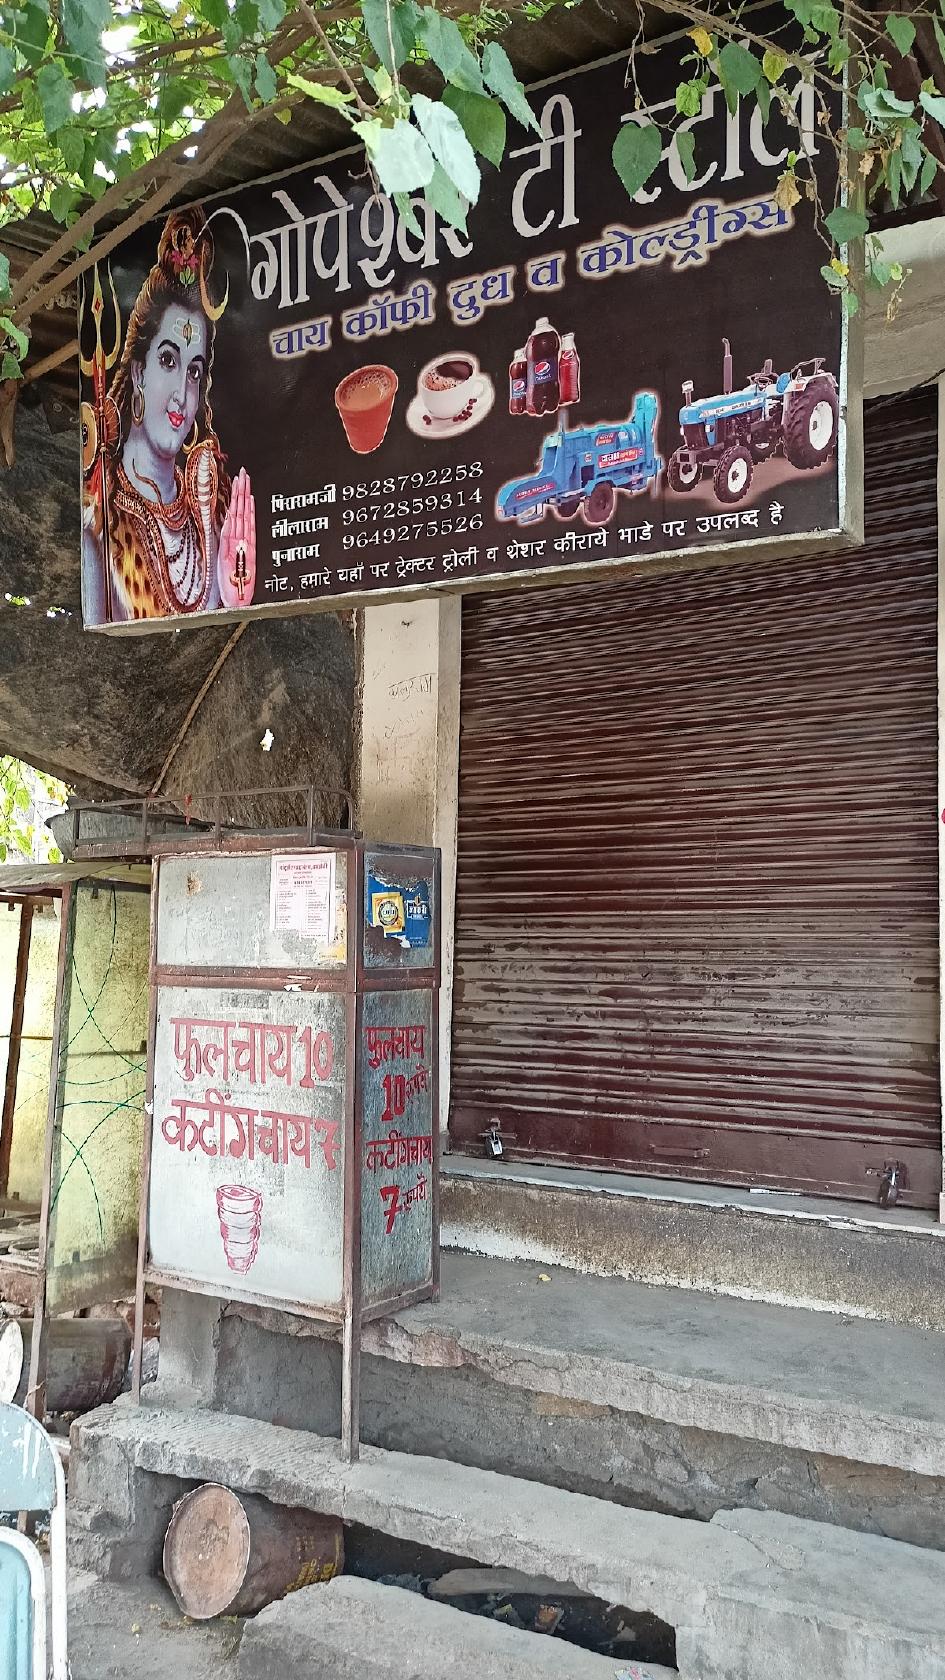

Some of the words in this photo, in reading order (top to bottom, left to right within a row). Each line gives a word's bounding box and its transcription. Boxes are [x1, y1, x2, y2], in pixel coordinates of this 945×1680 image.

[509, 94, 582, 238] टी
[272, 321, 329, 355] चाय
[346, 284, 433, 336] कॉफी
[451, 271, 511, 321] दुध
[530, 257, 561, 287] व
[342, 461, 484, 501] 9828792258
[271, 517, 329, 539] लीलाराम
[342, 488, 483, 526] 9672859314
[272, 543, 320, 567] पुनाराम
[342, 514, 484, 550] 9649275526
[299, 567, 332, 589] हमारे
[370, 562, 390, 578] पर
[395, 556, 436, 578] ट्रेक्टर
[442, 546, 479, 573] ट्रोली
[486, 547, 499, 562] व
[554, 527, 609, 553] कीराये
[618, 521, 654, 544] भाडे
[662, 520, 688, 537] पर
[768, 501, 785, 525] है
[298, 1026, 334, 1088] 10
[381, 1074, 406, 1122] 10
[314, 1118, 341, 1170] 7
[380, 1185, 401, 1235] 7
